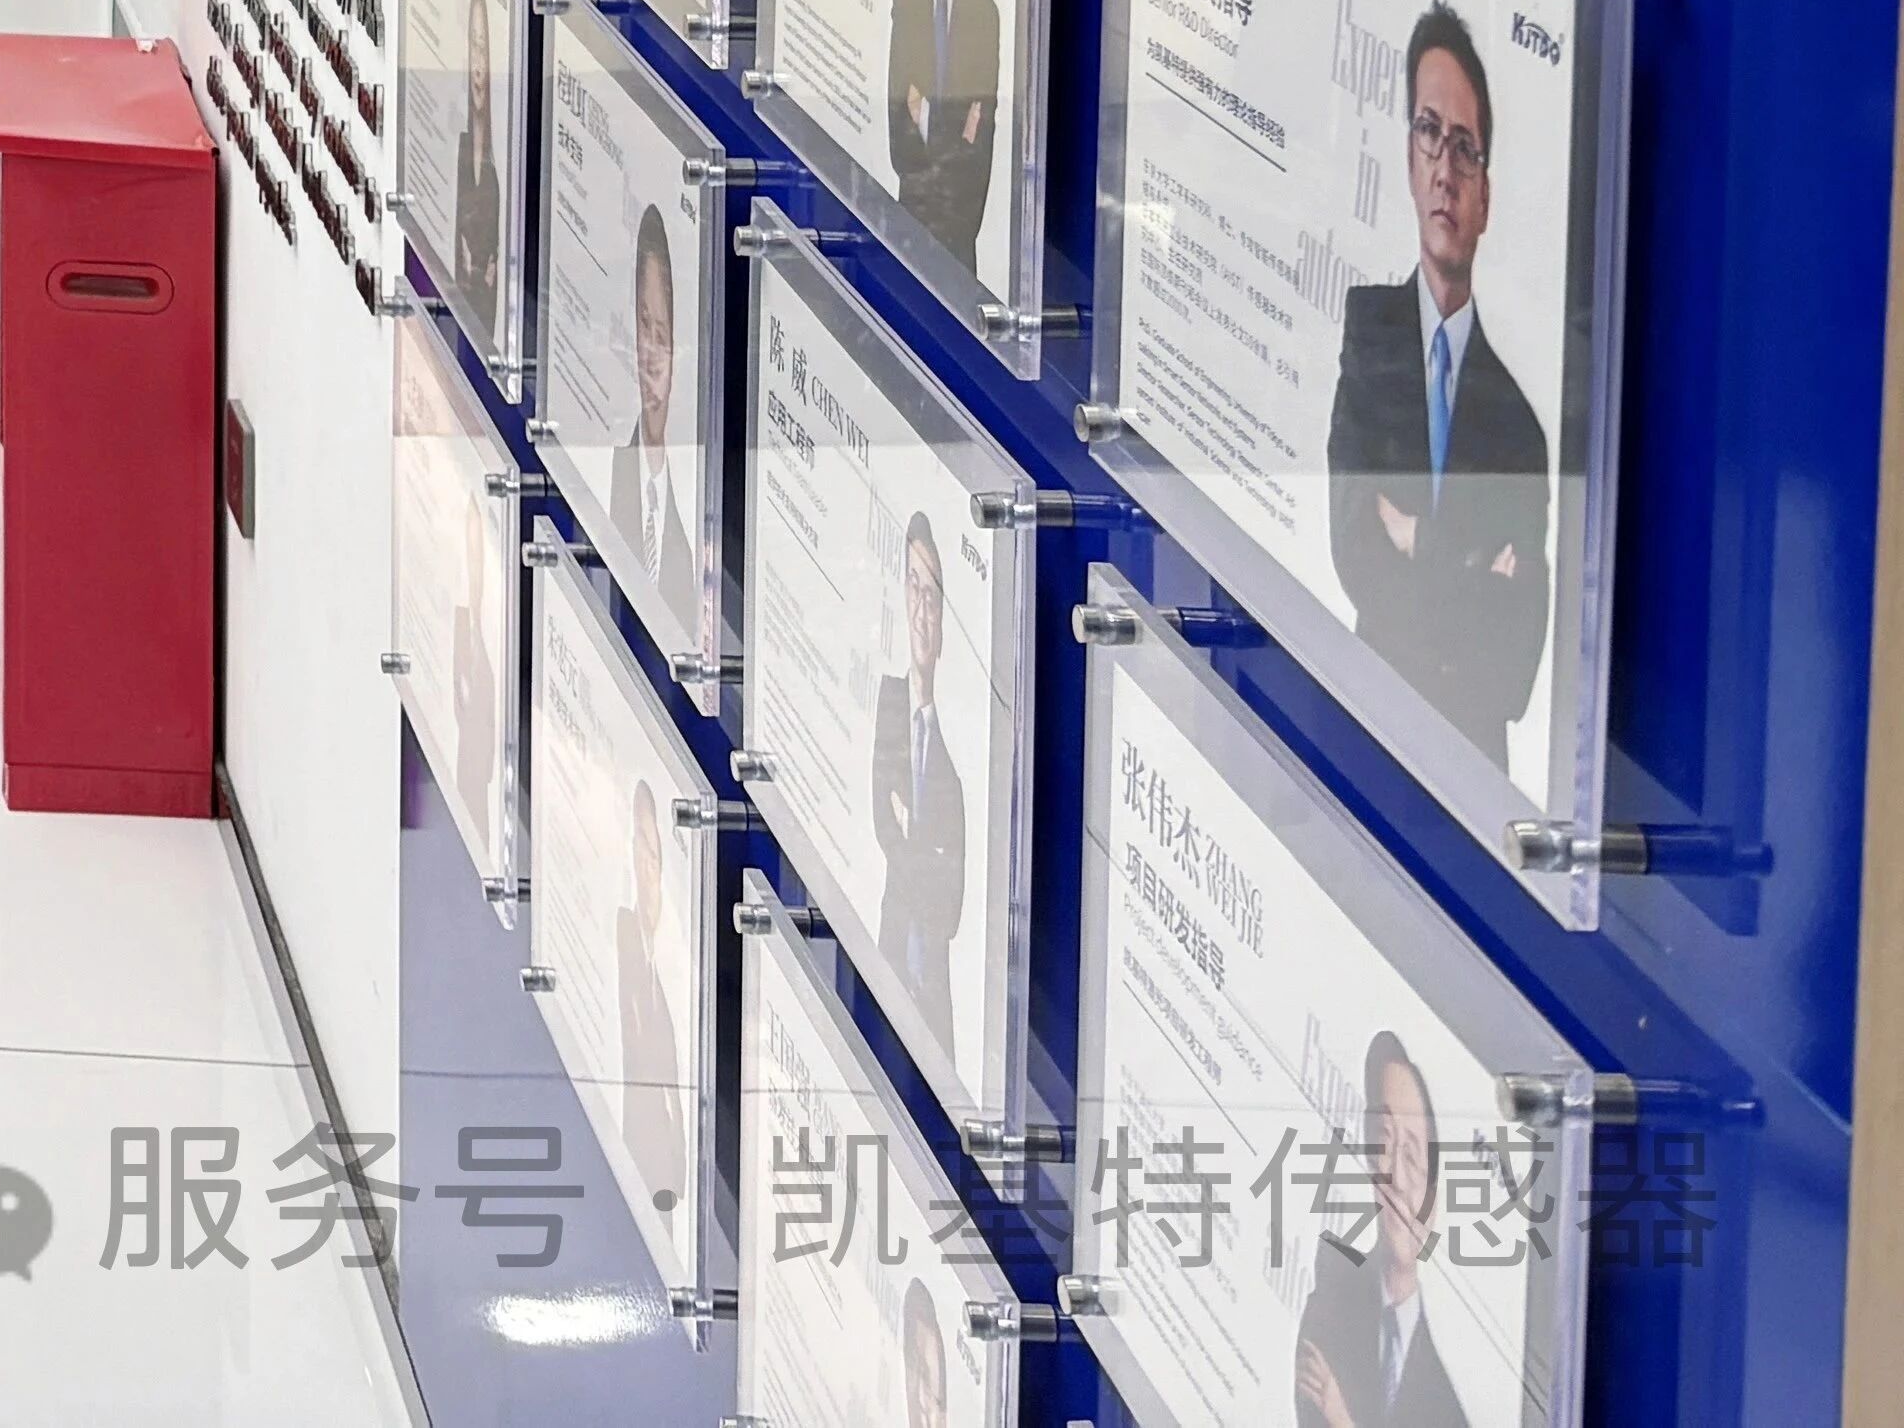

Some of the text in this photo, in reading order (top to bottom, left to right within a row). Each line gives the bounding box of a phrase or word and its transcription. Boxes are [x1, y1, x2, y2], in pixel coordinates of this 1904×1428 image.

[811, 375, 870, 470] CHEN WEI
[1121, 736, 1201, 890] 张伟杰
[1125, 840, 1225, 992] 项目研发指导
[1205, 834, 1264, 923] ZHANG
